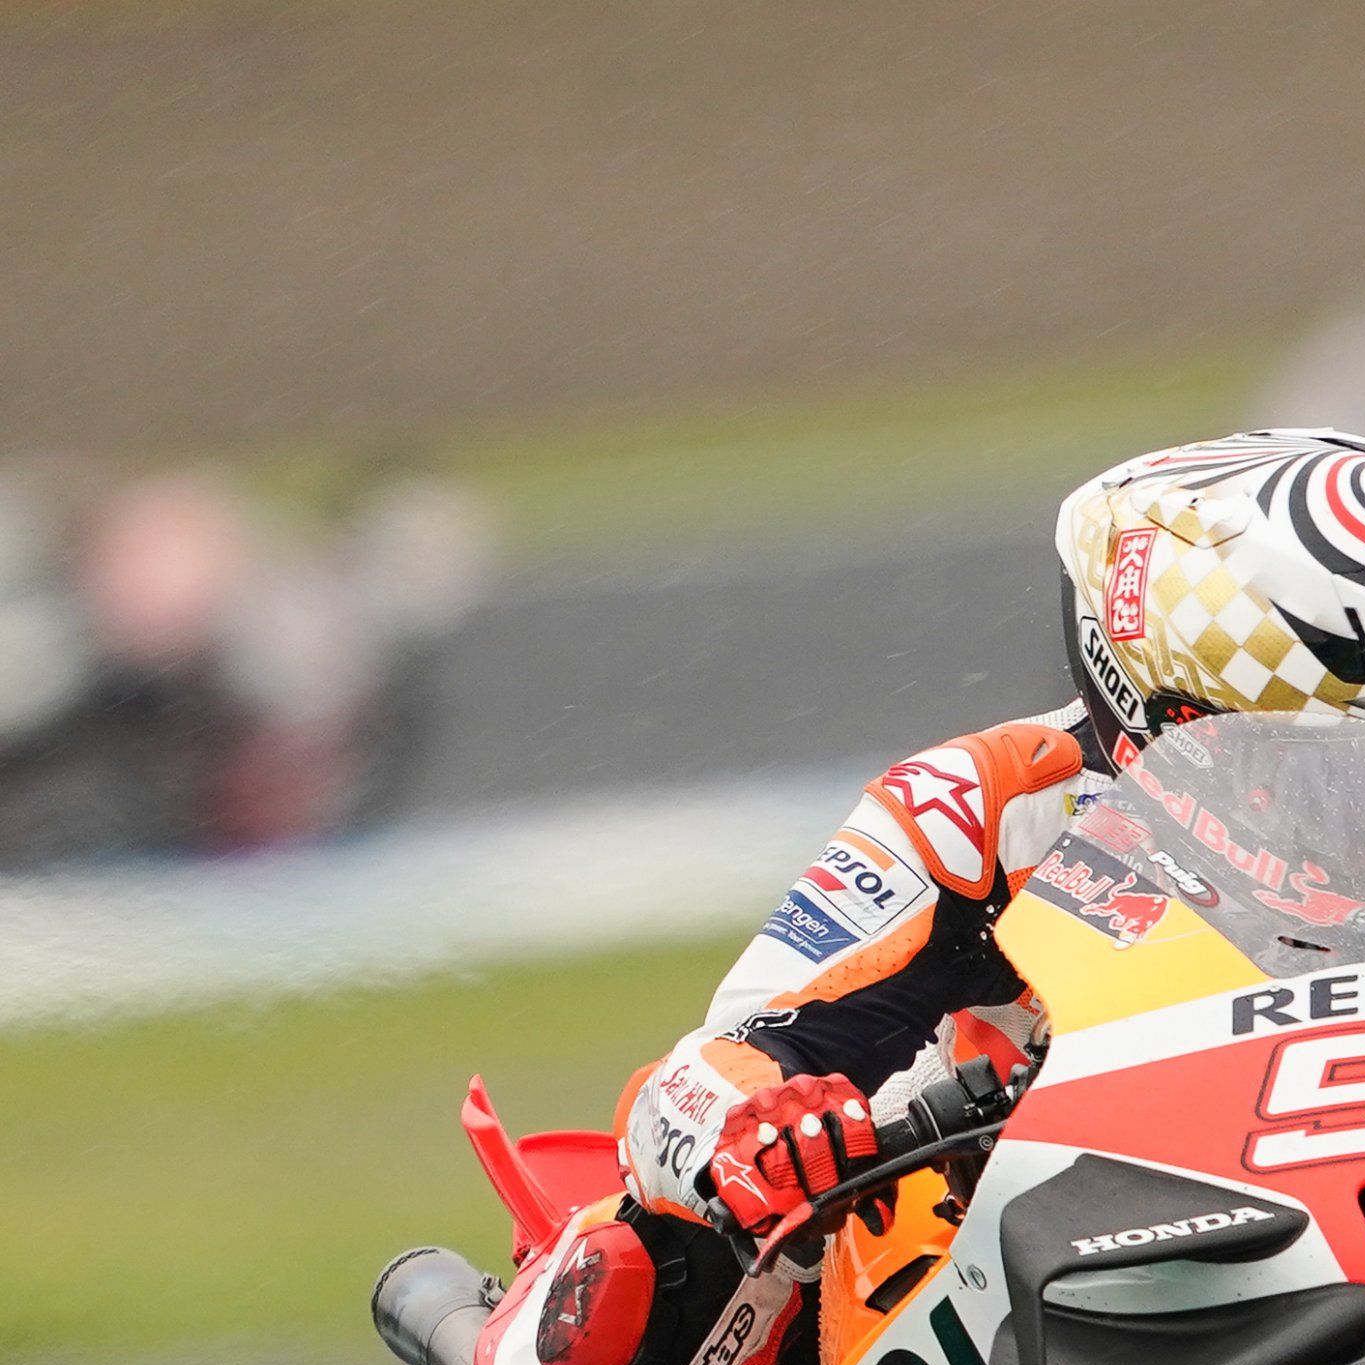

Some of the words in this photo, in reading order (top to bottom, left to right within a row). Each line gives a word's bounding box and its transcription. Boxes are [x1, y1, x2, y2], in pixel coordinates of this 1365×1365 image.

[1083, 628, 1141, 722] SHOEI
[1148, 851, 1208, 896] Puig
[1071, 1206, 1274, 1257] HONDA
